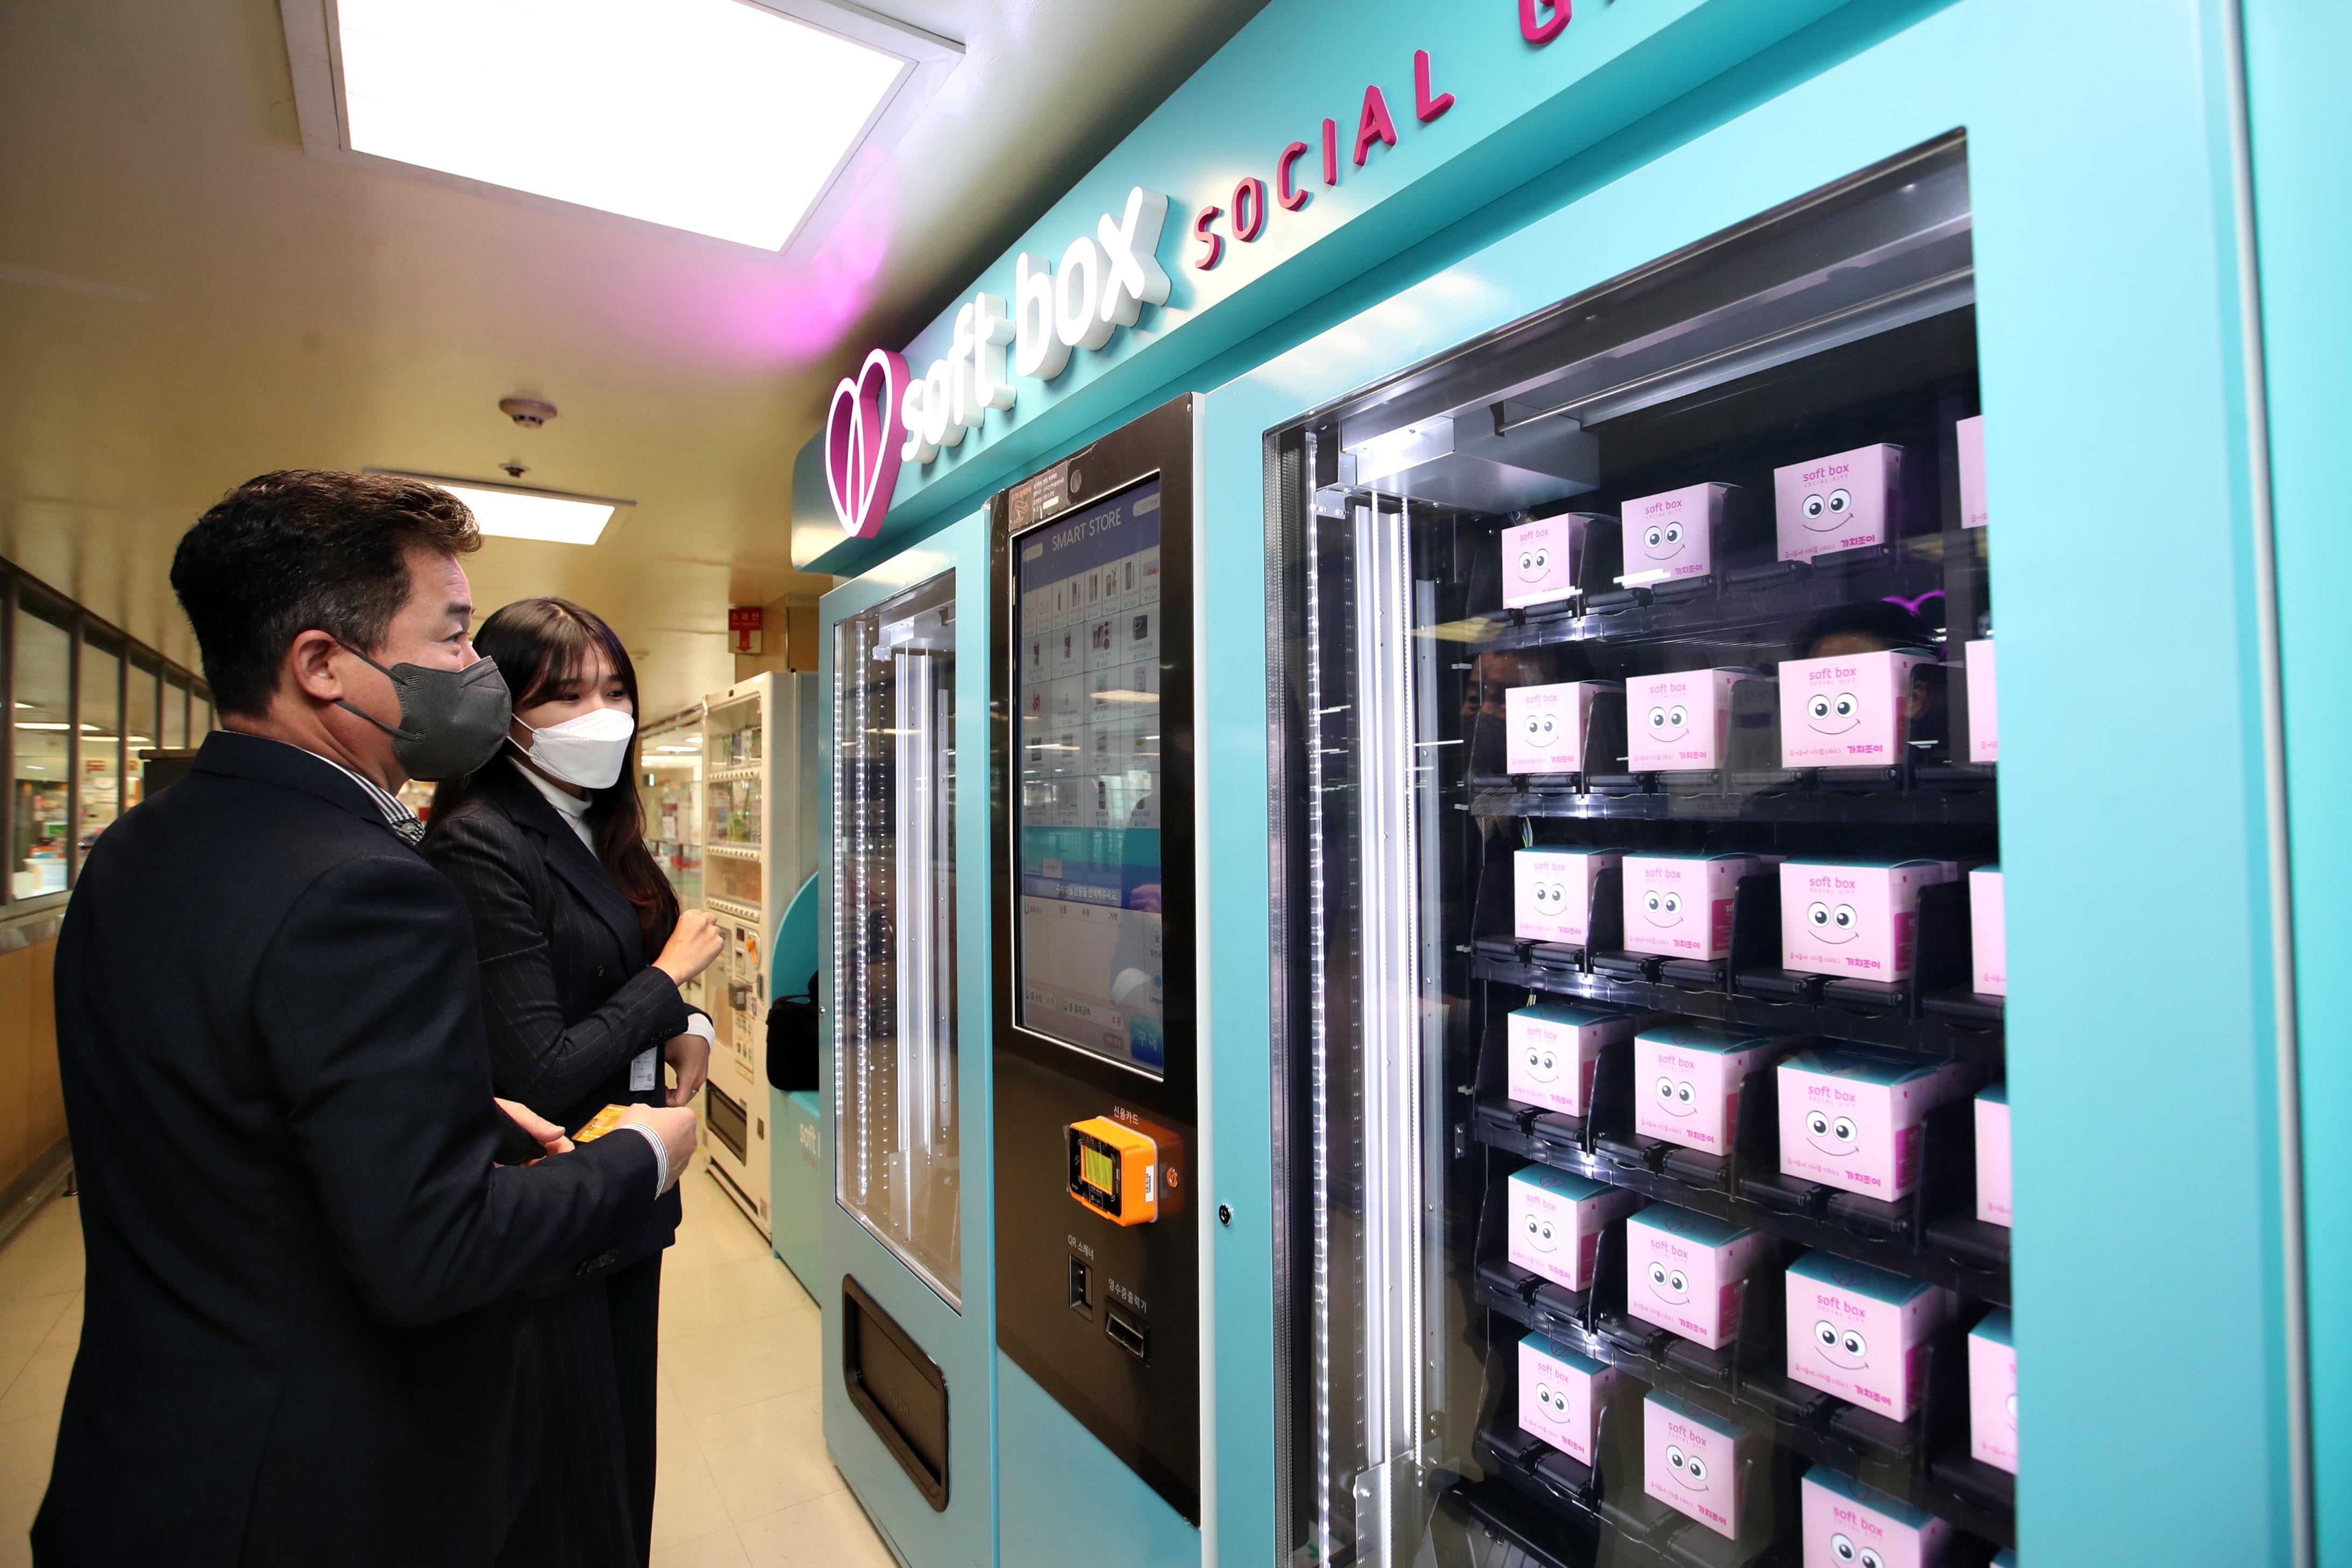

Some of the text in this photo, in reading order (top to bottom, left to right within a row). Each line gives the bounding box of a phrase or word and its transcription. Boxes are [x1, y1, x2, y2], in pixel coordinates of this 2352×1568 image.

[1194, 49, 1455, 270] SOCIAL
[901, 186, 1171, 464] soft box
[1803, 464, 1849, 482] soft box
[1804, 473, 1848, 487] SOCIAL GIFT
[1645, 500, 1682, 514] soft box
[1052, 522, 1087, 552] SMART
[1089, 507, 1122, 536] STORE
[1520, 530, 1534, 541] soft
[1536, 529, 1548, 537] box
[1840, 534, 1875, 548] 가치조이
[1675, 564, 1702, 575] 가치조이
[1809, 667, 1857, 680] soft box
[1650, 682, 1686, 694] soft box
[1526, 694, 1557, 703] soft box
[1678, 751, 1706, 759] 가치조이
[1847, 745, 1883, 754] 가치조이
[1534, 861, 1565, 871] soft box
[1645, 867, 1681, 879] soft box
[1809, 876, 1856, 889] soft box
[1109, 912, 1118, 922] 가격
[1672, 939, 1700, 949] 가치조이
[1845, 957, 1880, 969] 가치조이
[1527, 1027, 1541, 1037] soft
[1544, 1029, 1557, 1040] box
[1658, 1054, 1695, 1069] soft box
[1808, 1086, 1856, 1103] soft box
[1113, 1105, 1139, 1125] 신용카드
[1686, 1129, 1713, 1143] 가치조이
[1845, 1170, 1881, 1187] 가치조이
[1527, 1194, 1540, 1206] soft
[1543, 1198, 1556, 1212] box
[1068, 1235, 1094, 1261] QR 스캐너
[1650, 1239, 1688, 1259] soft box
[1108, 1278, 1147, 1314] 영수증출력기
[1817, 1294, 1866, 1319] soft box
[1678, 1318, 1706, 1336] 가치조이
[1538, 1362, 1569, 1383] soft box
[1854, 1384, 1891, 1406] 가치조이
[1668, 1422, 1706, 1447] soft box
[1697, 1504, 1726, 1526] 가치조이
[1833, 1507, 1857, 1525] soft
[1861, 1517, 1882, 1537] box
